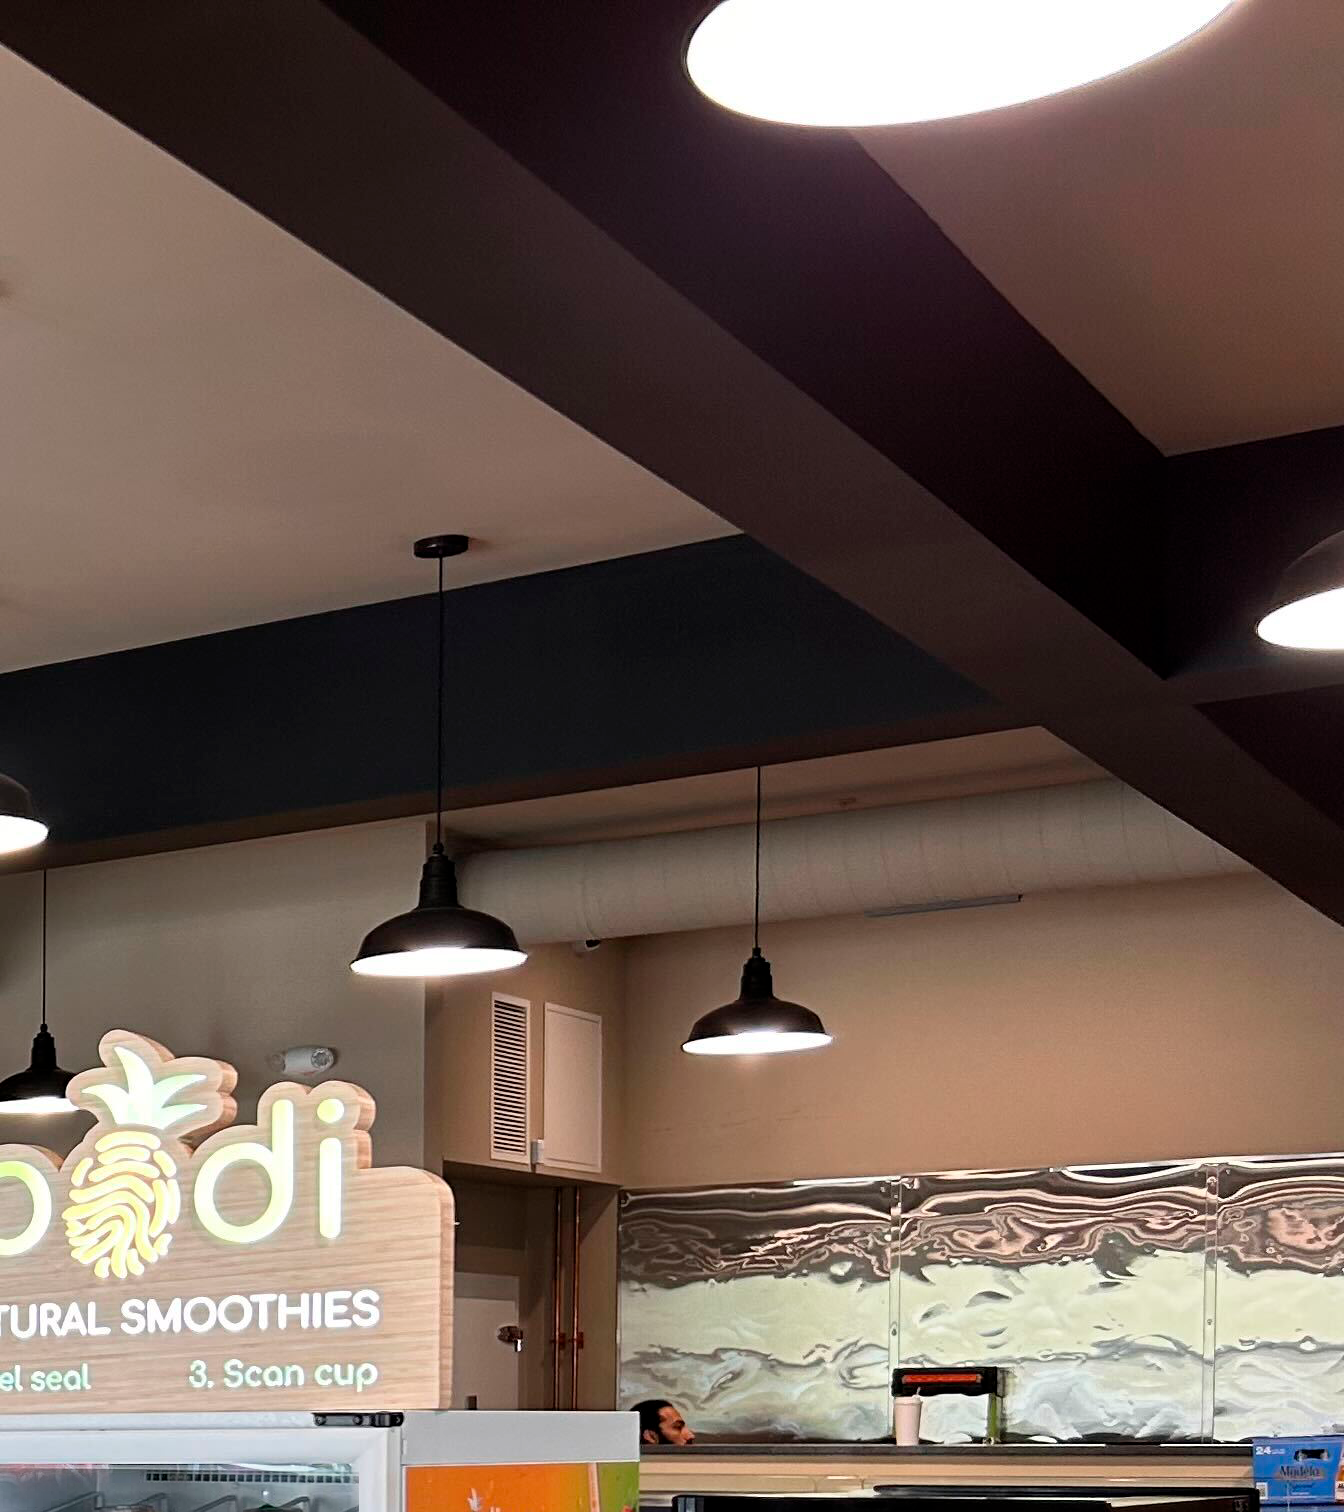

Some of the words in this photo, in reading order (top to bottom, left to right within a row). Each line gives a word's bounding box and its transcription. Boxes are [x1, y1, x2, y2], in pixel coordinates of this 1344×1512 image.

[120, 1289, 381, 1335] SMOOTHIES
[30, 1363, 91, 1392] seal
[189, 1361, 214, 1389] 3.
[223, 1359, 309, 1388] Scan
[314, 1362, 379, 1394] cup
[1255, 1446, 1272, 1455] 24
[1279, 1465, 1321, 1477] Modelo
